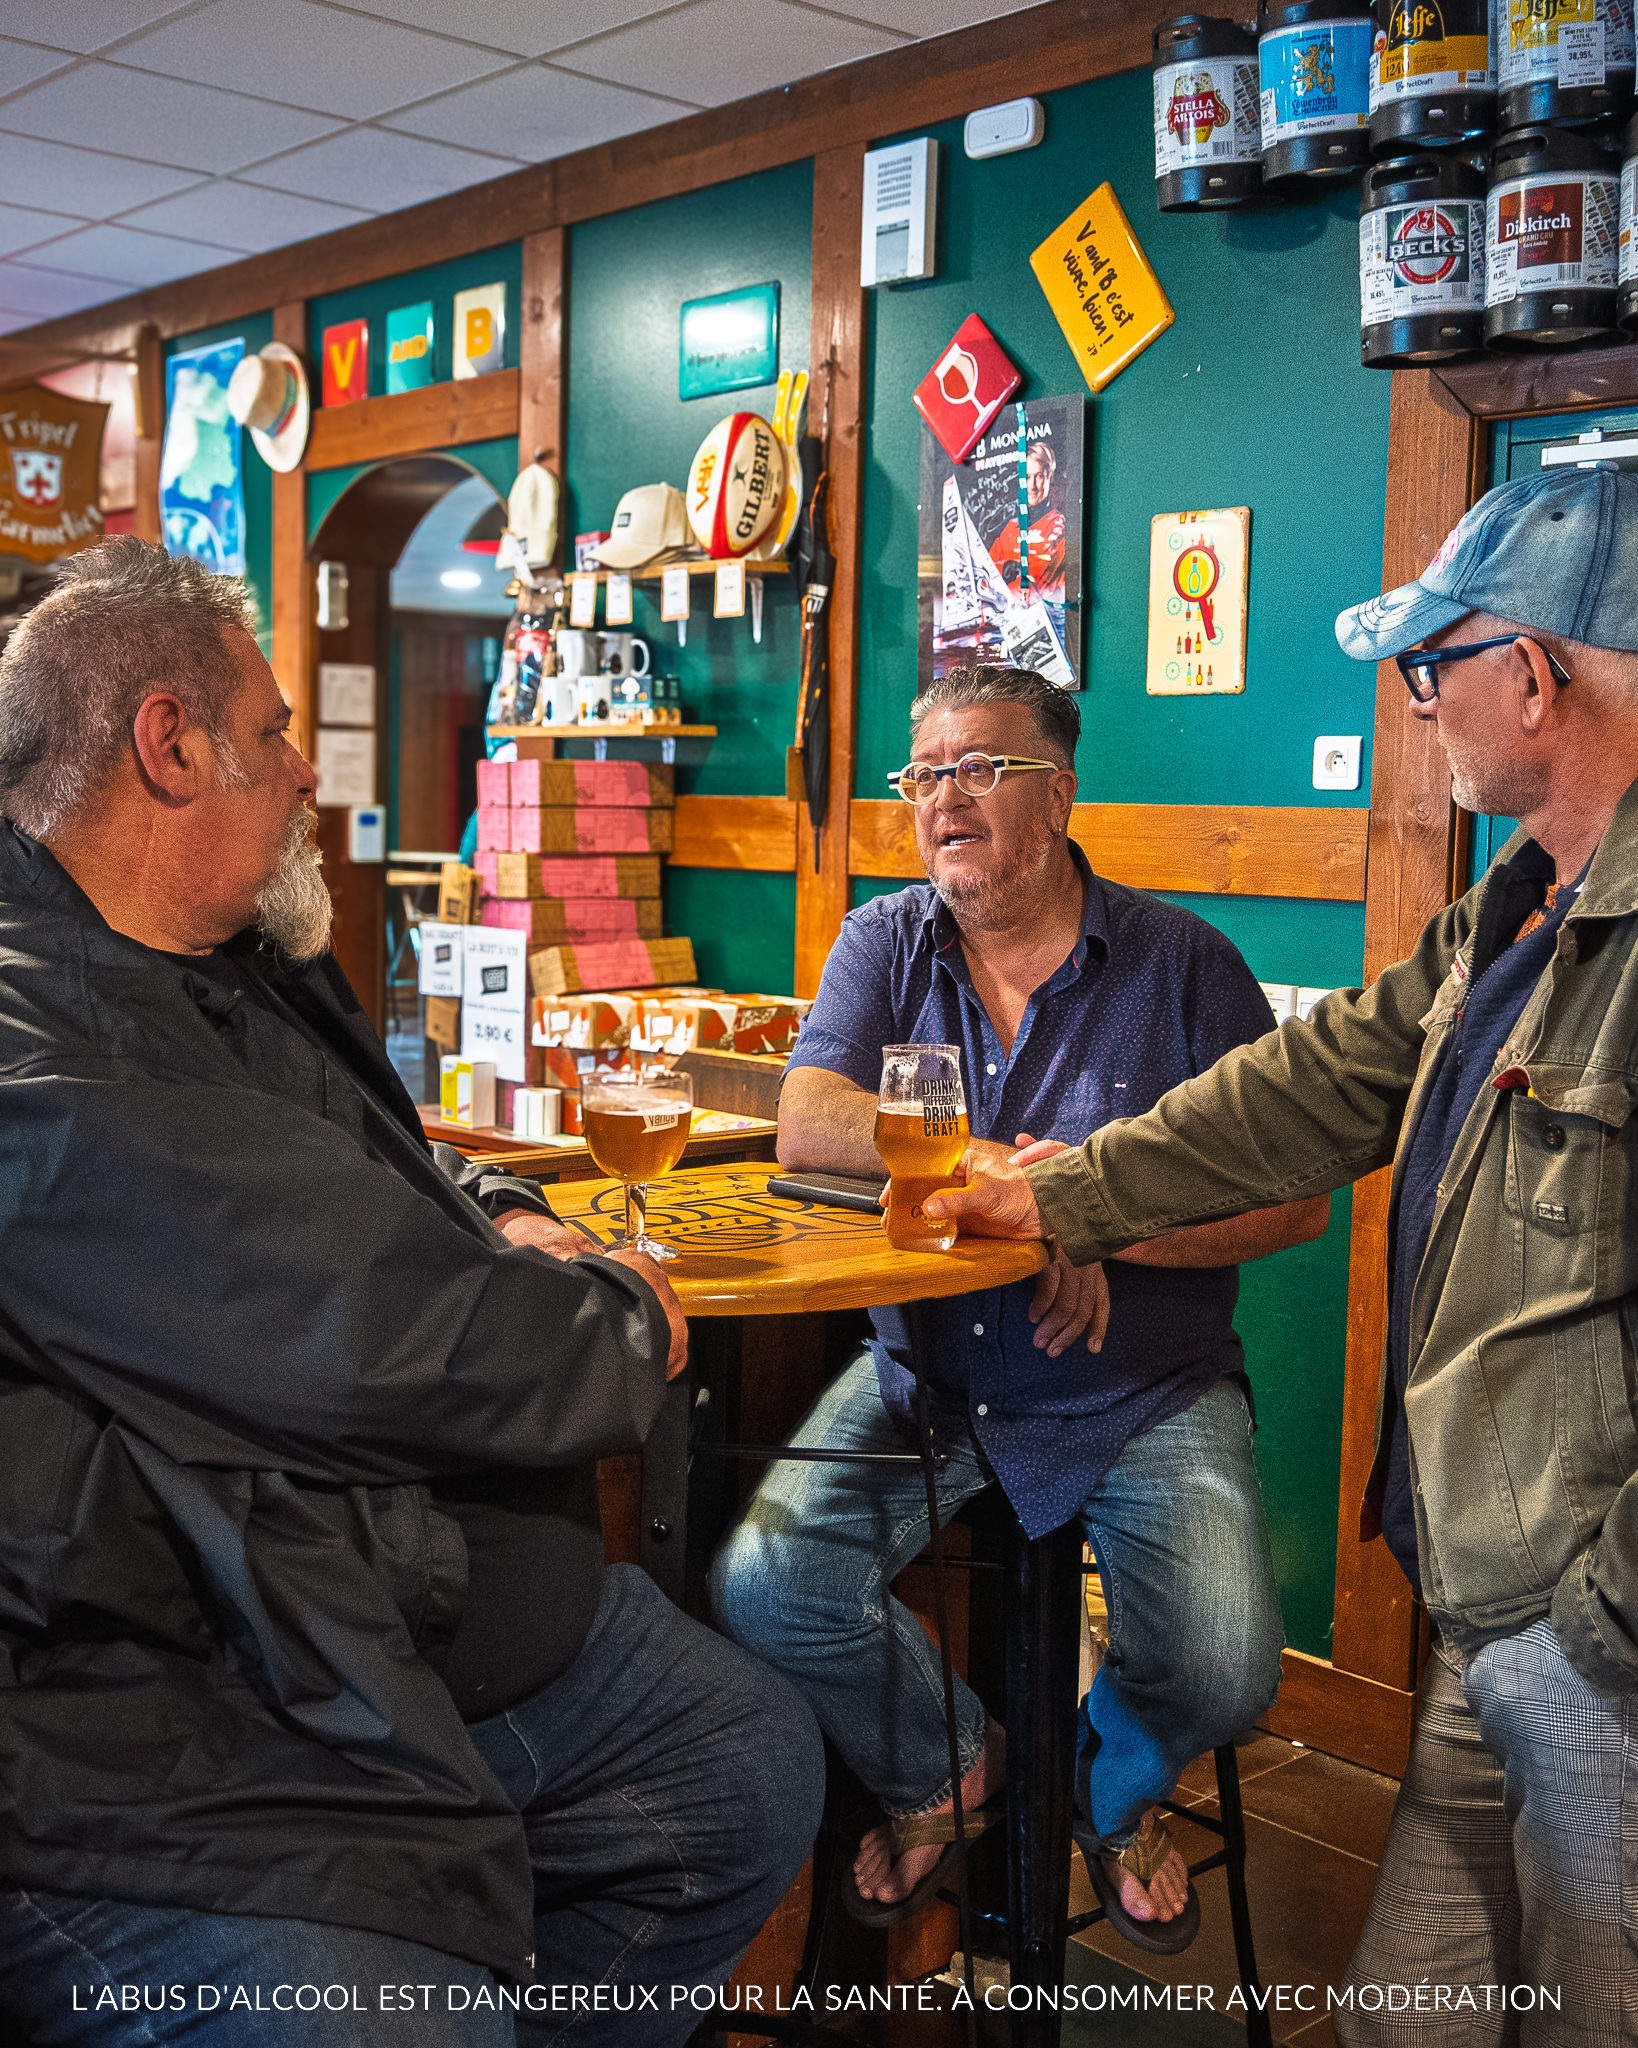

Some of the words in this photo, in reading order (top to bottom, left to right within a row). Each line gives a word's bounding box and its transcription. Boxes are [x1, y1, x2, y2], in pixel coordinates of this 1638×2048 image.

[1395, 5, 1436, 39] Leffe
[1173, 98, 1214, 114] STELLA
[1173, 108, 1215, 124] ARTOIS
[1076, 219, 1097, 242] V
[1504, 213, 1572, 239] Diekirch
[1540, 230, 1554, 240] CRU
[1085, 244, 1110, 276] and
[1389, 236, 1466, 260] BECK'S
[1099, 267, 1118, 291] B
[1082, 292, 1108, 337] bien
[1106, 291, 1135, 329] c'est
[329, 338, 358, 389] V
[388, 334, 429, 363] AND
[466, 307, 493, 359] B
[0, 411, 78, 451] Tripel
[990, 423, 1052, 450] MONANA
[736, 429, 770, 539] GILBERT
[504, 1027, 514, 1044] €
[923, 1079, 955, 1096] DRINK
[923, 1094, 956, 1106] DIFFERENT
[924, 1105, 958, 1123] DRINK
[924, 1121, 959, 1138] CRAFT
